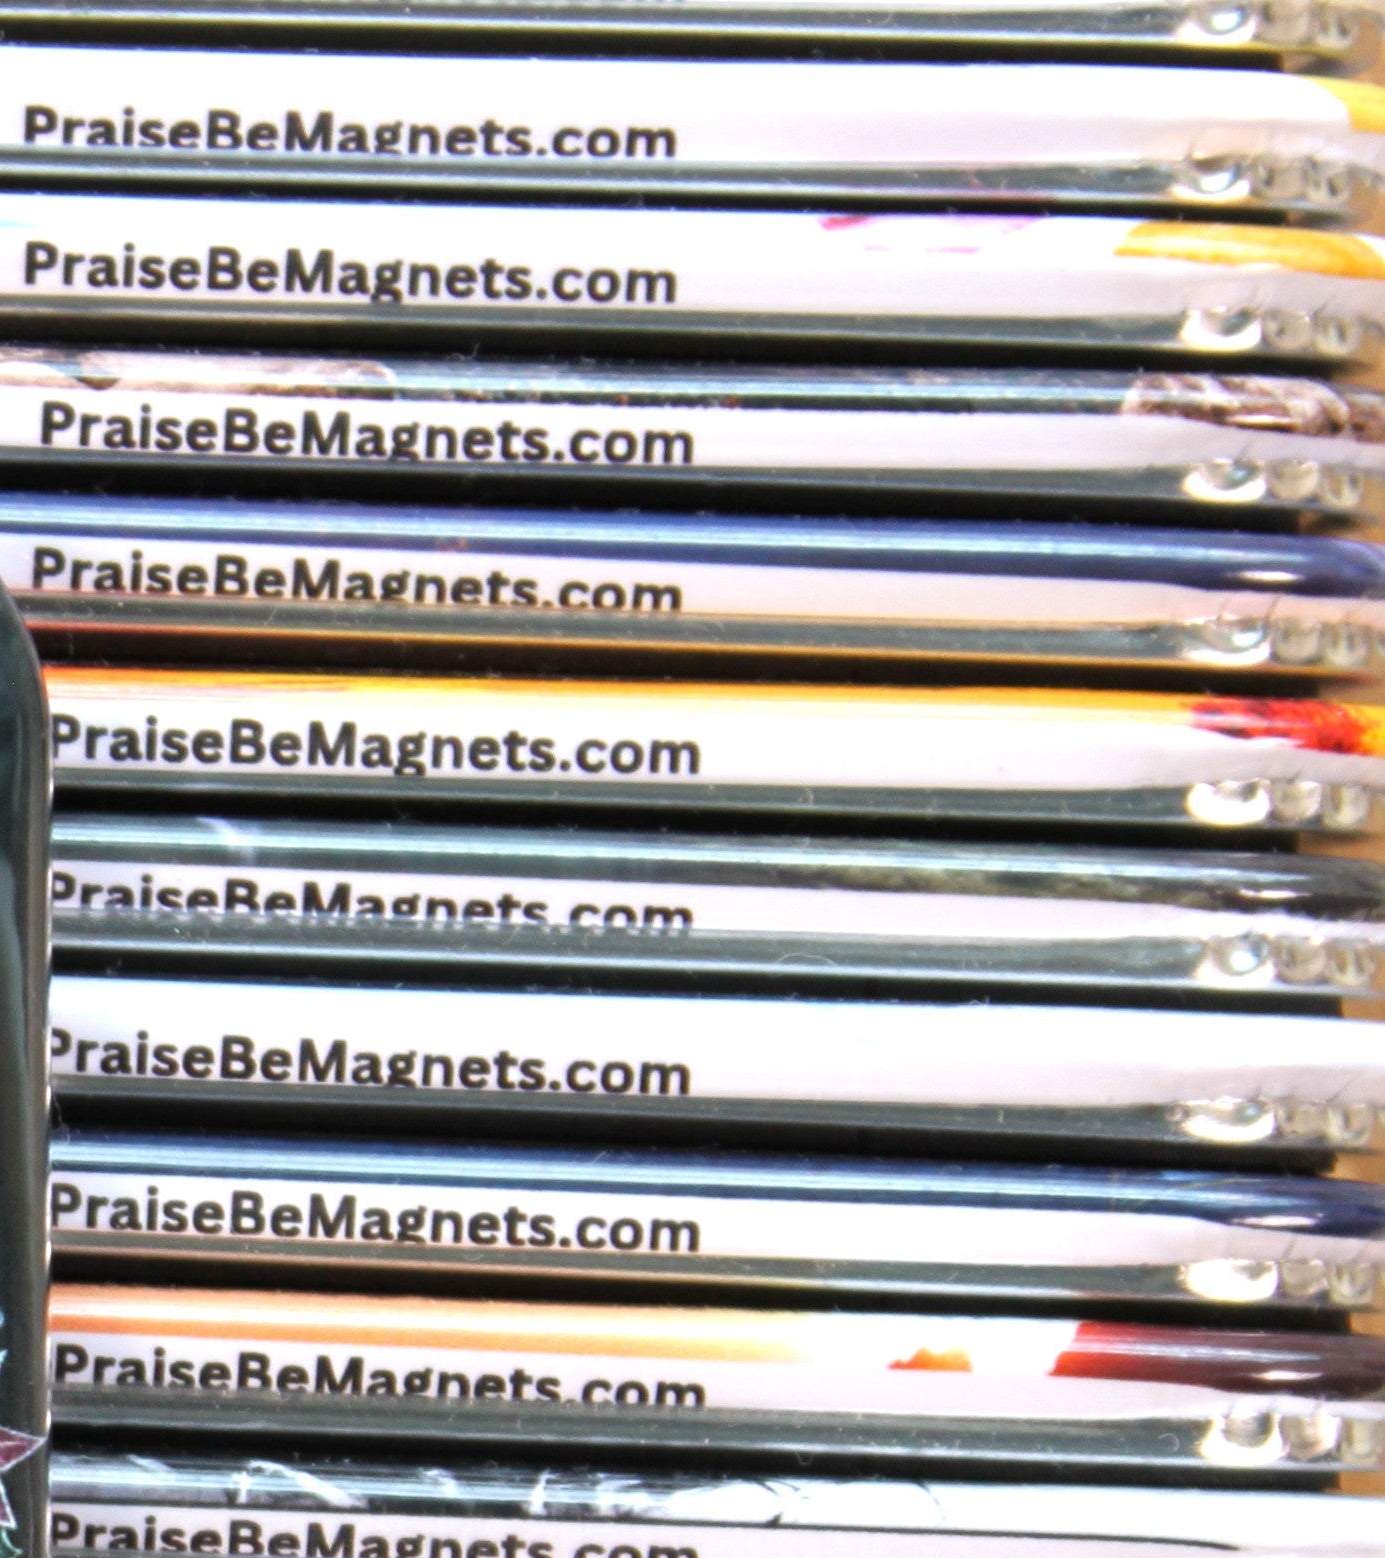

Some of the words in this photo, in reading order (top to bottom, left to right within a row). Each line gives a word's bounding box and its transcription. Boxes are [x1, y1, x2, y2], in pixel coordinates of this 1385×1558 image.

[25, 105, 676, 158] PraiseBeMagnets.com
[25, 242, 676, 304] PraiseBeMagnets.com
[41, 401, 693, 464] PraiseBeMagnets.com
[33, 547, 682, 612] PraiseBeMagnets.com
[52, 714, 701, 776] PraiseBeMagnets.com
[52, 871, 693, 927] PraiseBeMagnetscom
[52, 1028, 691, 1095] PraiseBeMagnets.com
[52, 1183, 701, 1252] PraiseBeMagnets.com
[54, 1342, 705, 1410] PraiseBeMagnets.com
